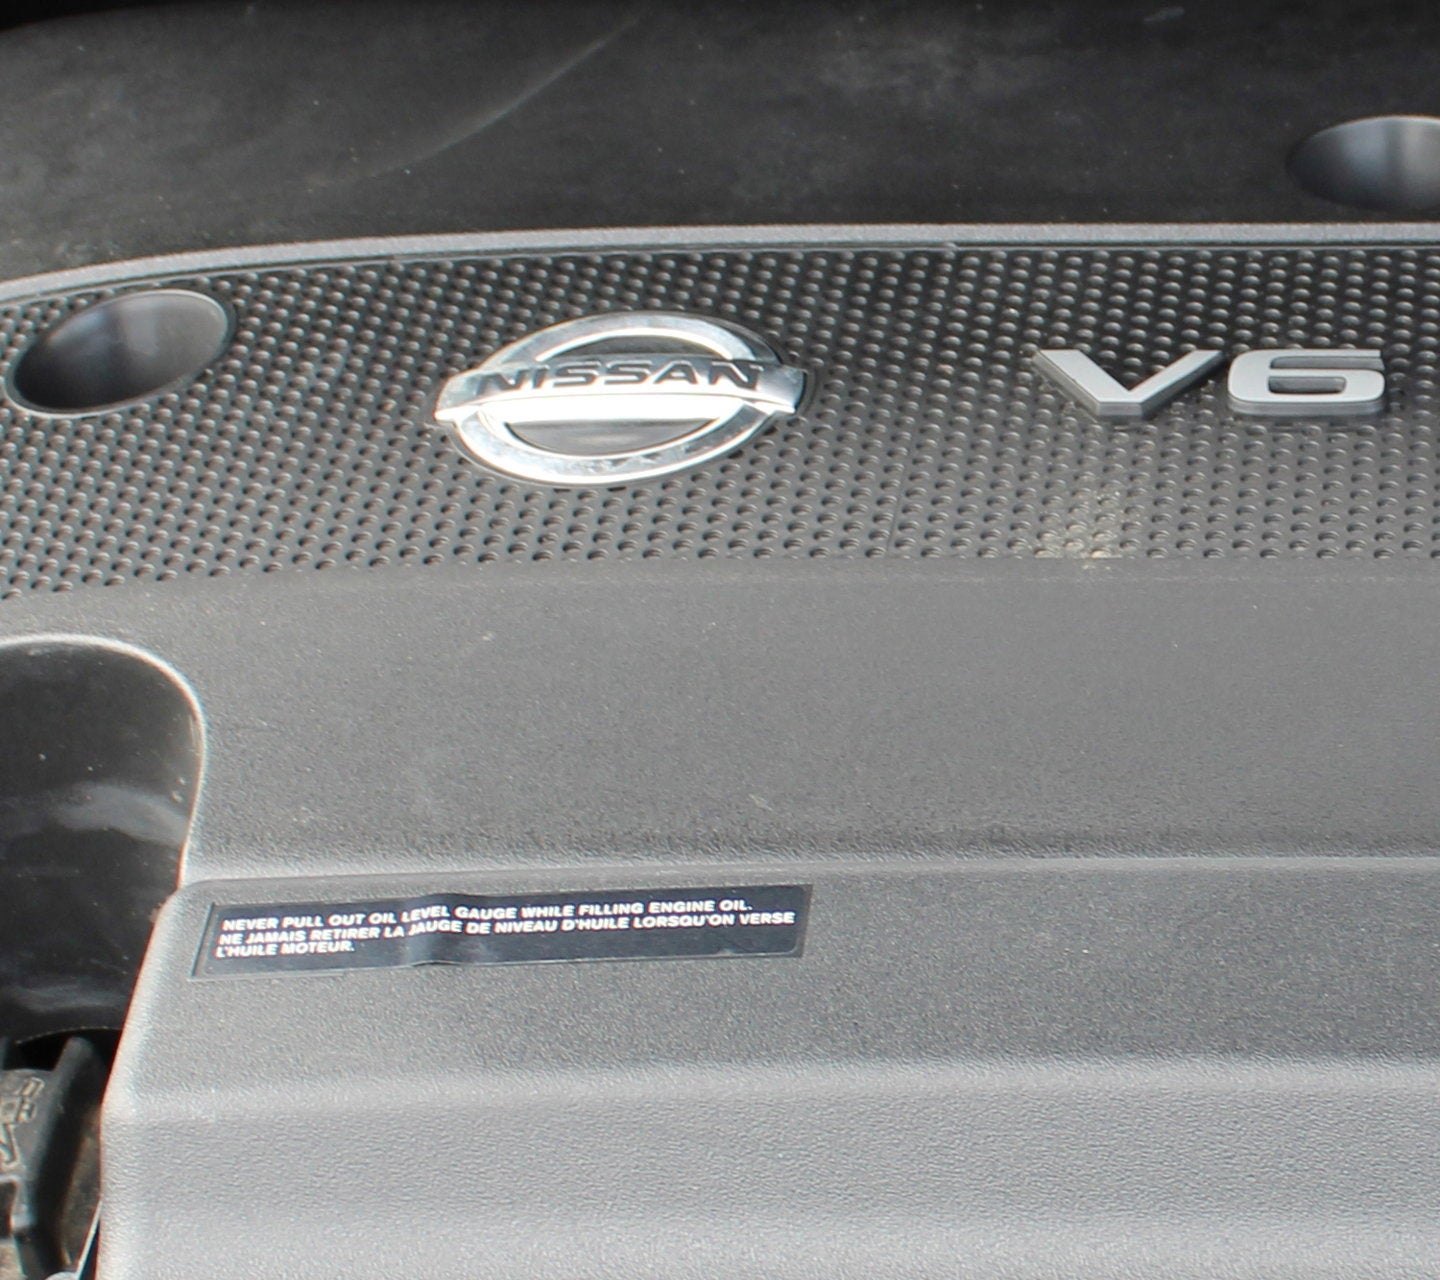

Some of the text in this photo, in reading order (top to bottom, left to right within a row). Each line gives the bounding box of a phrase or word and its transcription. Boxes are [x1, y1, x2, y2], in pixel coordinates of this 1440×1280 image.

[477, 359, 763, 397] NISSAN
[1032, 349, 1386, 417] V6
[218, 911, 796, 945] NE JAMAIS RETIRER LA JAUGE DE NIVEAU D'HUILE LORSQU'ON VERSE
[222, 898, 754, 932] NEVER PULL OUT OIL LEVEL GAUGE WHILE FILLING ENGINE OIL.
[215, 940, 356, 959] L'HUILE MOTEUR.
